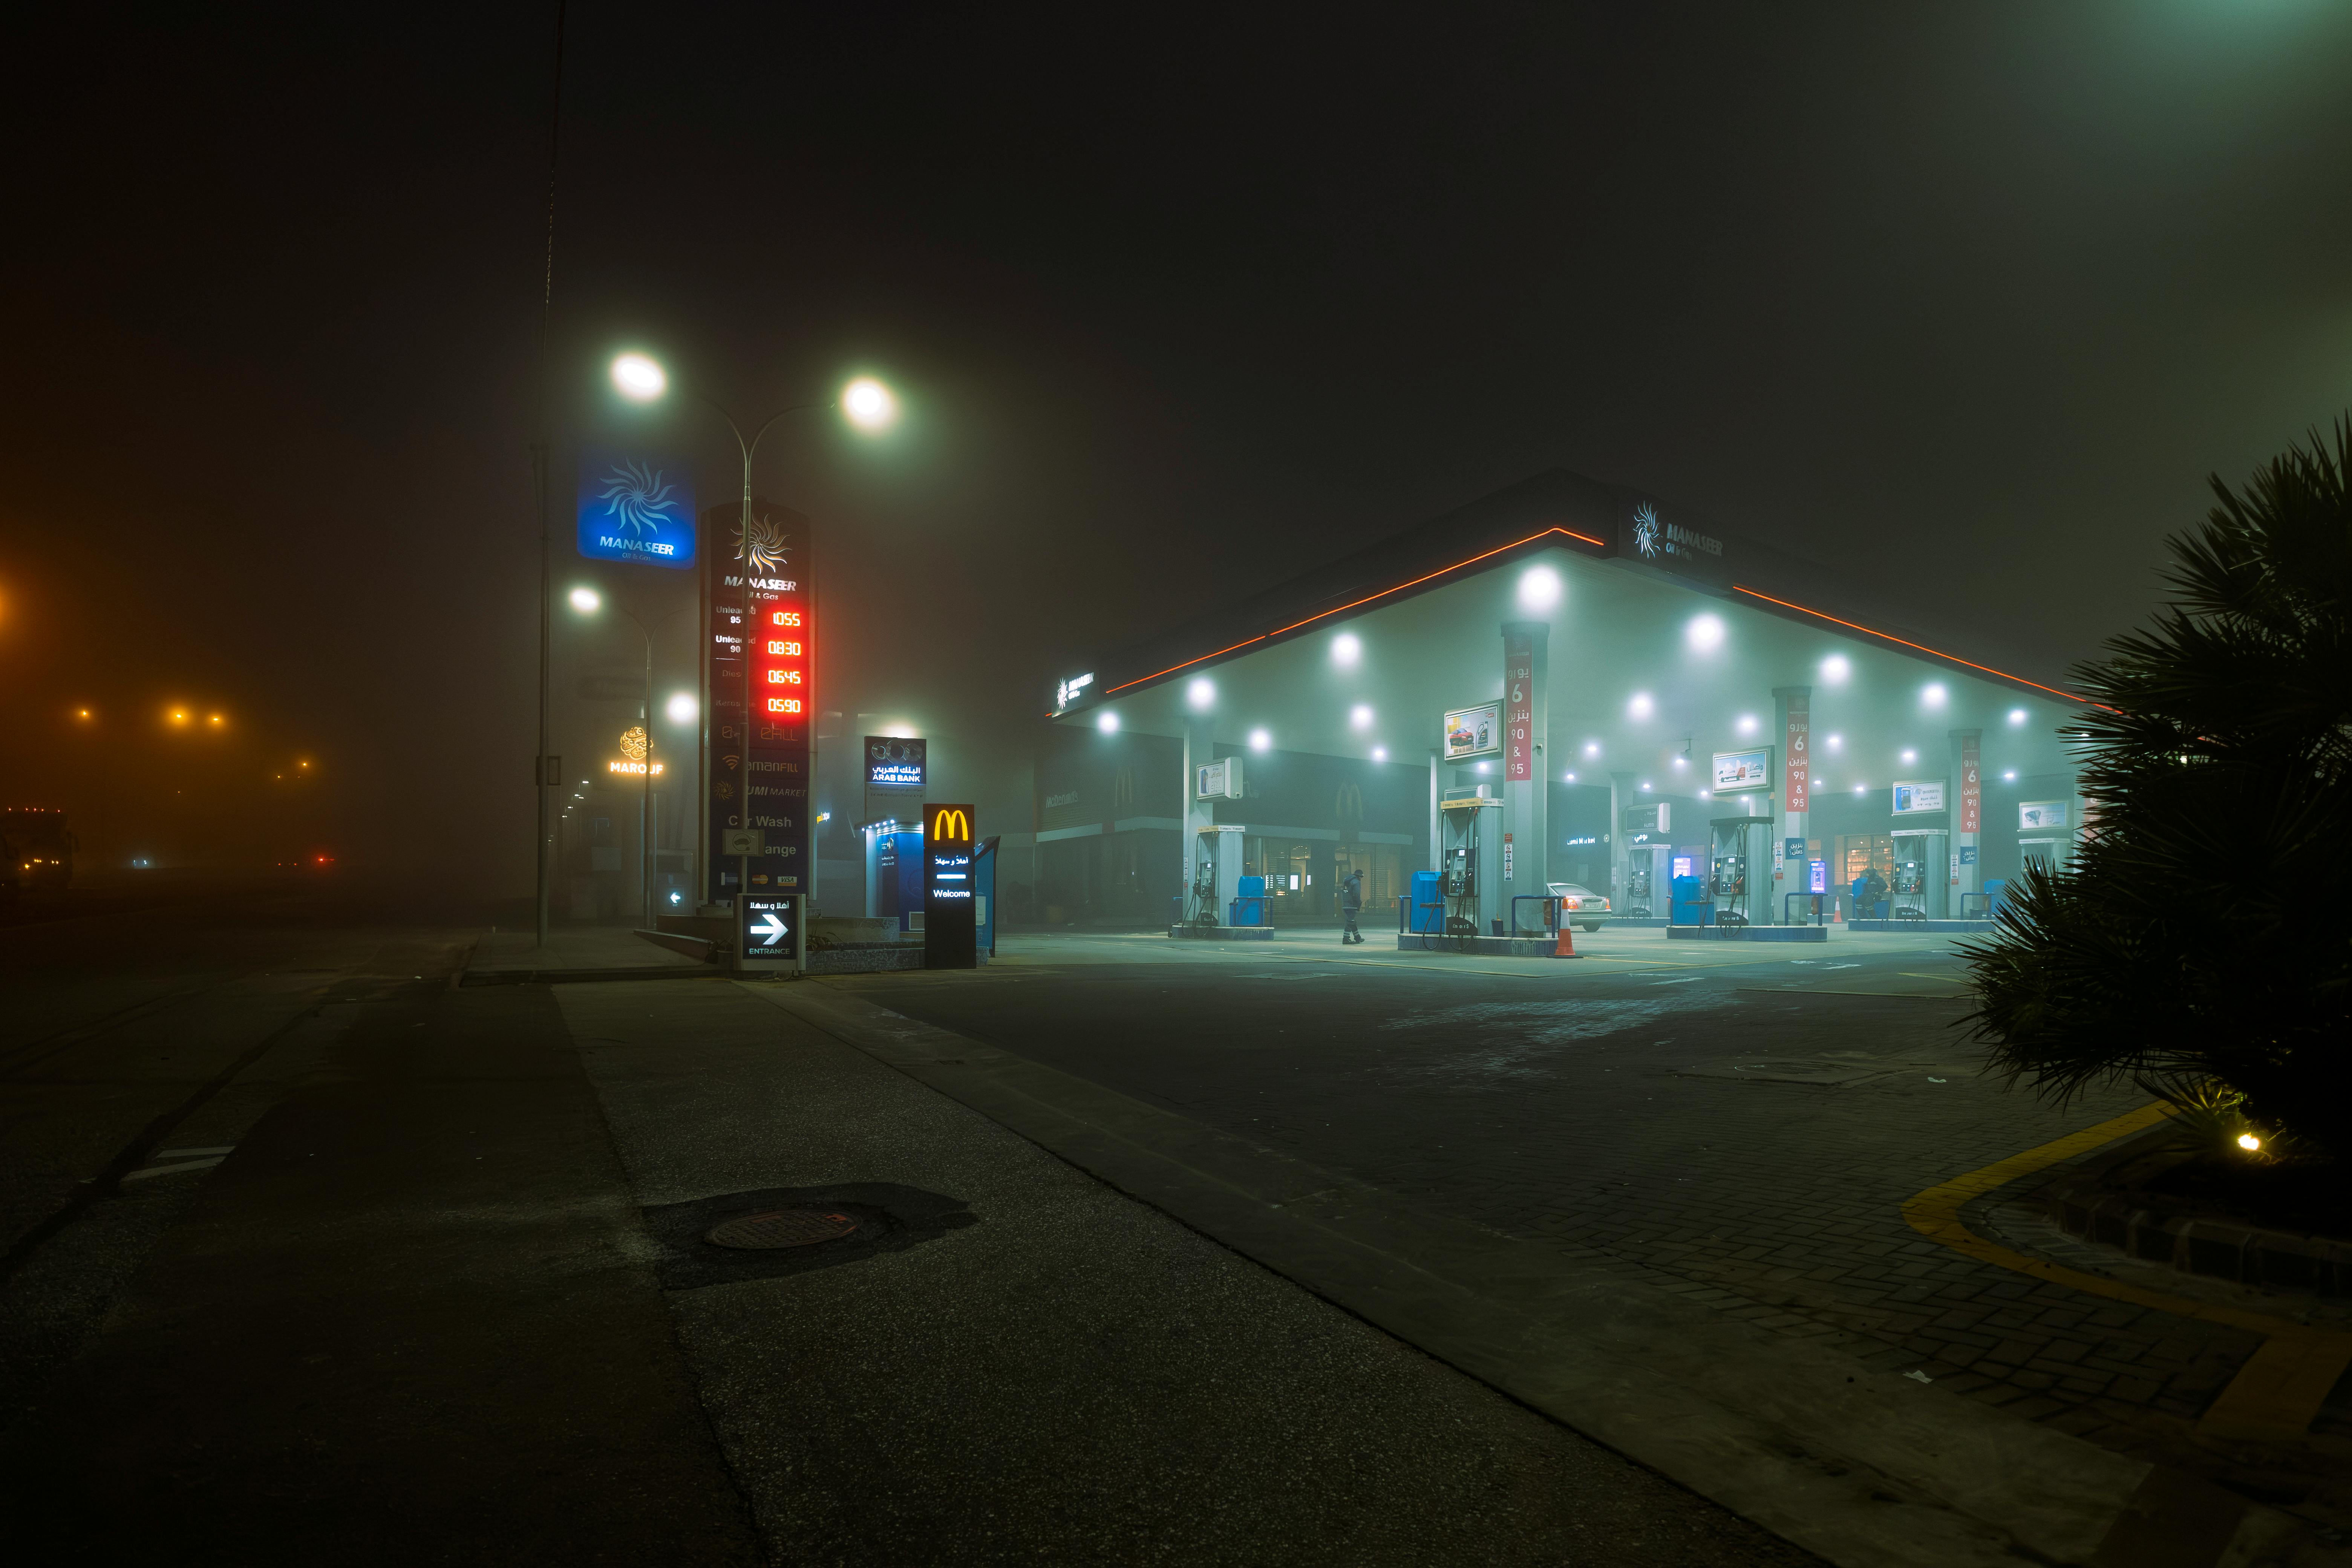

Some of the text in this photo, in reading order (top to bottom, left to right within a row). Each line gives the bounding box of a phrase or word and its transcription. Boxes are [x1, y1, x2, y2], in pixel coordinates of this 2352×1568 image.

[1667, 523, 1723, 556] MANASEER
[600, 536, 674, 555] MANASEER
[1512, 683, 1523, 703] 6
[1508, 710, 1529, 723] بنزين
[1511, 729, 1524, 740] 90
[1795, 736, 1804, 751] 6
[1514, 746, 1521, 757] &
[1789, 756, 1807, 767] بنزين
[873, 766, 920, 775] البنك العربي
[1511, 763, 1524, 774] 95
[1793, 771, 1804, 780] 90
[1968, 770, 1976, 782] 6
[748, 786, 807, 797] UMI MARKET
[1796, 785, 1802, 793] &
[1793, 799, 1804, 807] 95
[728, 815, 792, 827] Cr Wash
